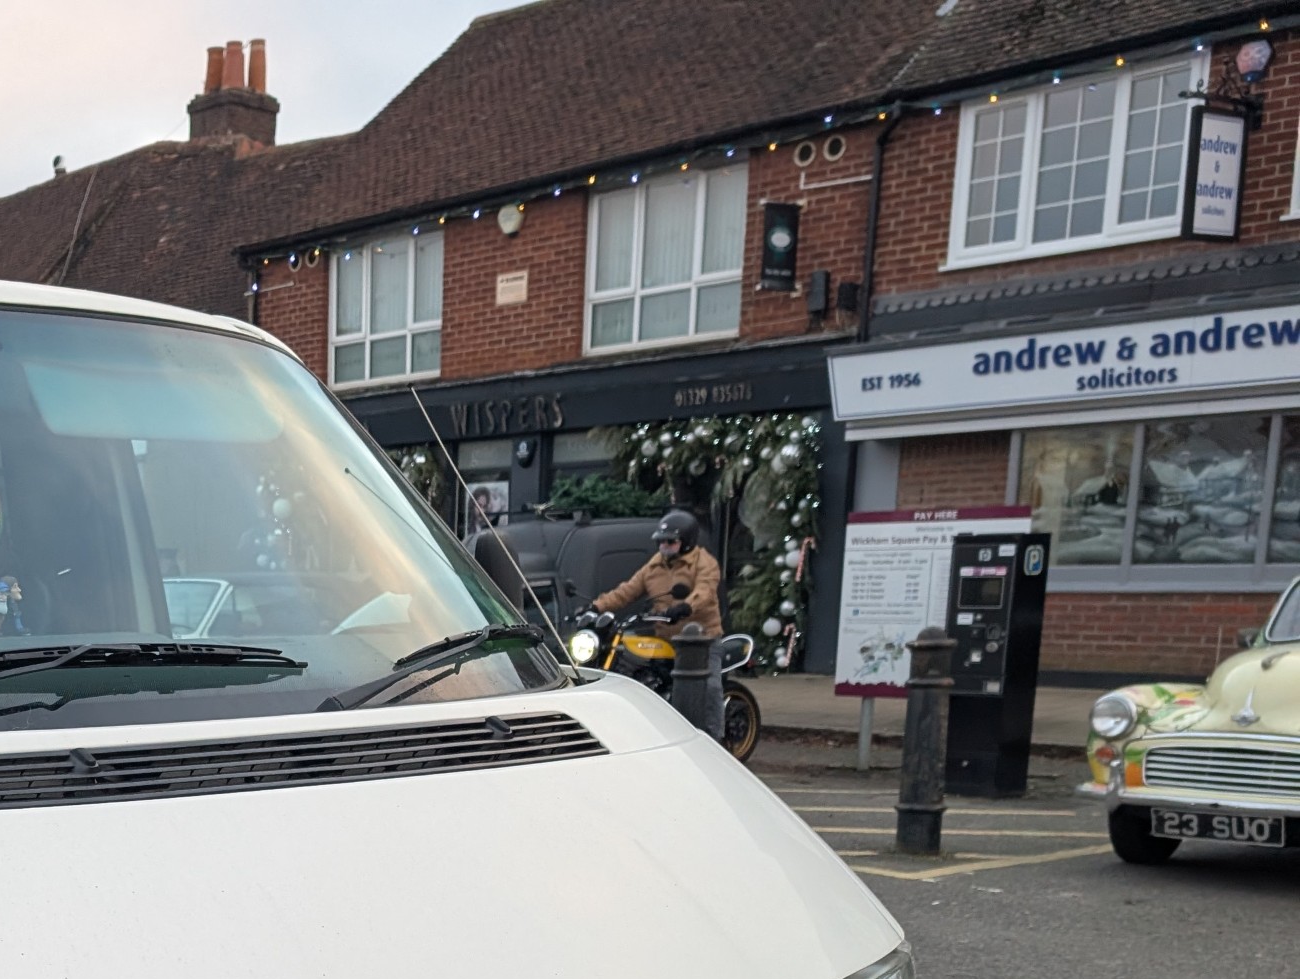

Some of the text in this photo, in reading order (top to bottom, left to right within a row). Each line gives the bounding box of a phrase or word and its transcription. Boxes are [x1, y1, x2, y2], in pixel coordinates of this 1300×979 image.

[1200, 135, 1238, 155] andrew
[1214, 161, 1220, 173] &
[1196, 181, 1234, 200] andrew
[972, 316, 1300, 376] andrew & andrew
[861, 372, 921, 392] EST 1956
[1076, 366, 1178, 391] solicitors
[451, 392, 566, 437] WISPERS
[914, 510, 958, 520] PAY HERE
[851, 536, 889, 546] Wickham
[891, 536, 920, 547] Square
[1164, 812, 1270, 843] 23 SUO
